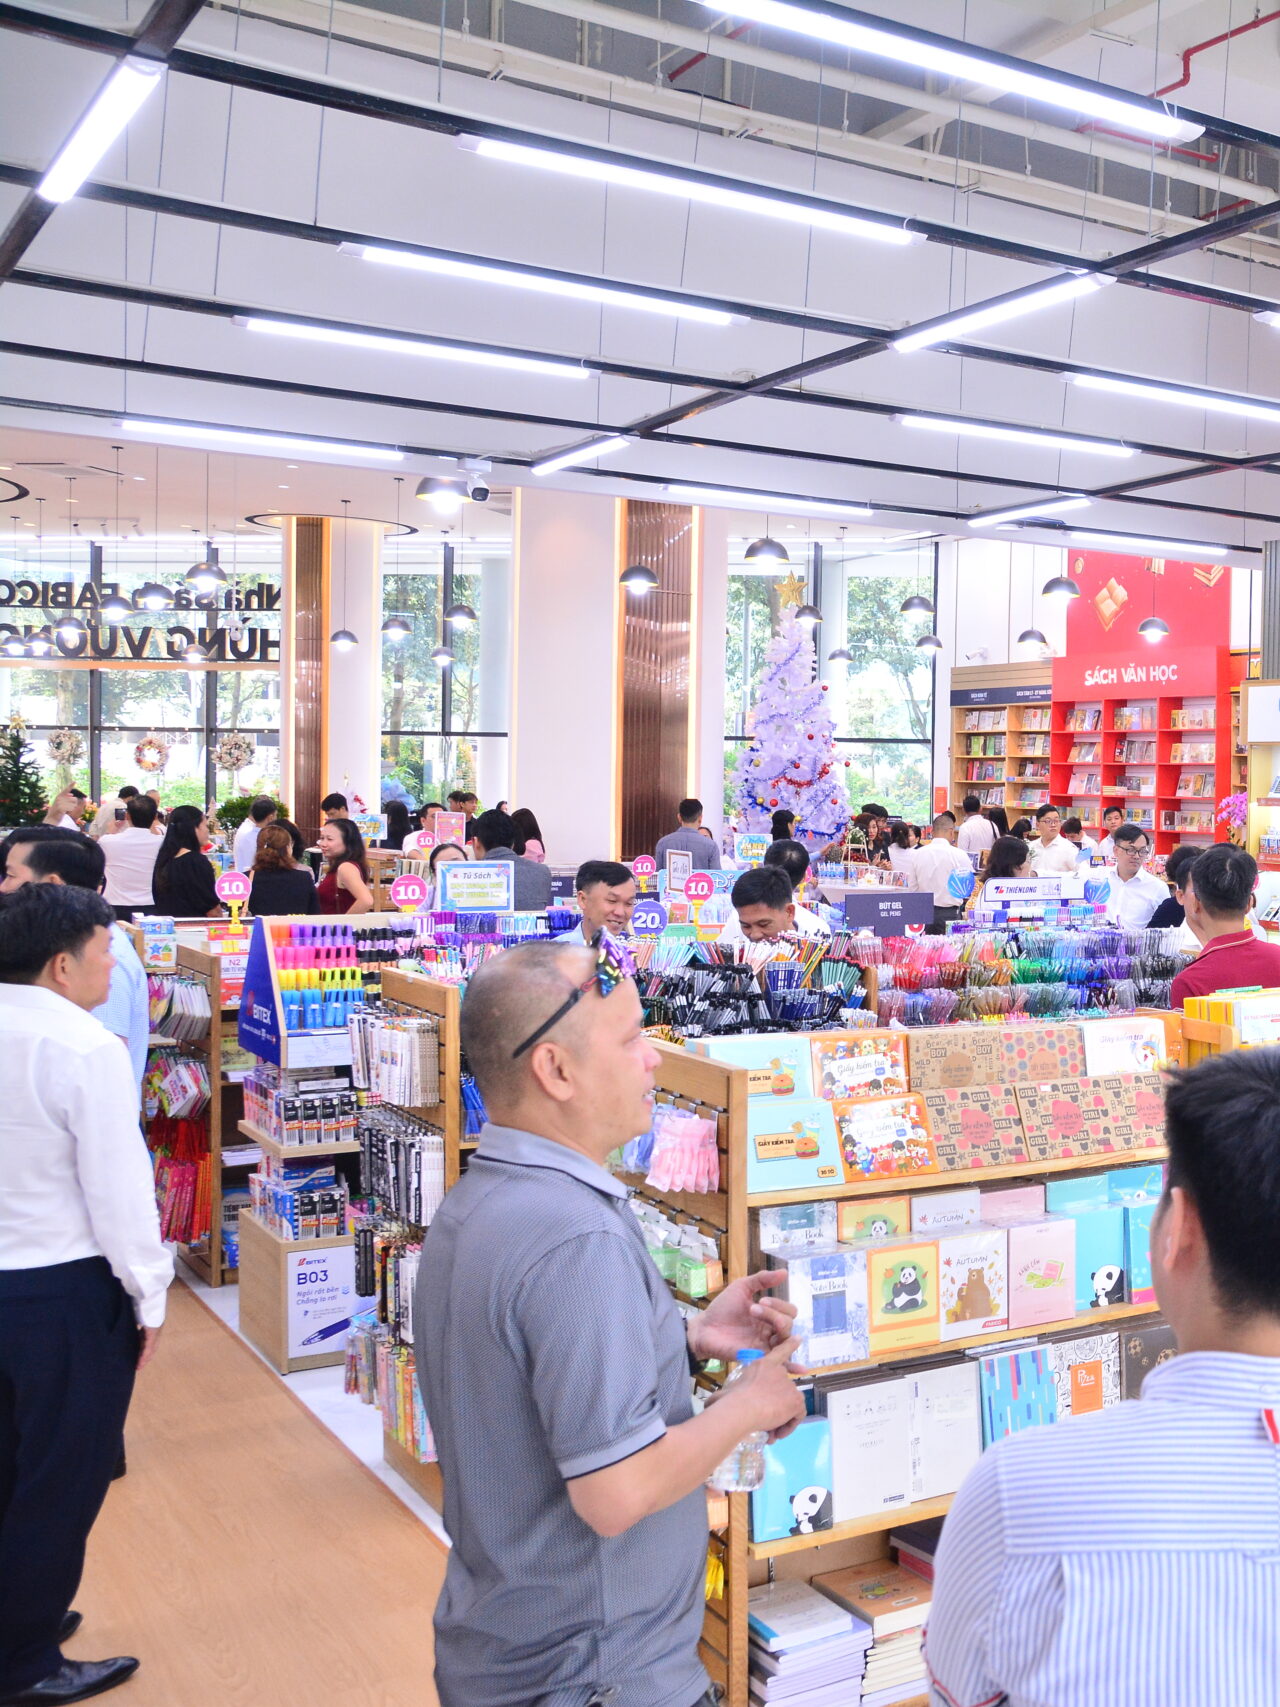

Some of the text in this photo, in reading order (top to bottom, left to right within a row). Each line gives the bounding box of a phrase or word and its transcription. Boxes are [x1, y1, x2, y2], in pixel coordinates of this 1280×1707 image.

[1084, 662, 1178, 686] SÁCH VĂN HỌC
[473, 871, 492, 880] Sách
[879, 901, 903, 910] BÚT GEL
[931, 1049, 946, 1057] BOY
[977, 1046, 991, 1054] BOY
[1105, 1080, 1121, 1089] GIRL
[1145, 1076, 1160, 1085] GIRL
[1019, 1088, 1037, 1097] GIRL
[1062, 1084, 1079, 1093] GIRL
[927, 1097, 945, 1105] GIRL
[972, 1093, 990, 1101] GIRL
[1083, 1111, 1099, 1120] GIRL
[995, 1120, 1012, 1129] GIRL
[1115, 1126, 1132, 1135] GIRL
[1030, 1136, 1047, 1145] GIRL
[937, 1146, 955, 1155] GIRL
[932, 1213, 964, 1224] AUTUMN
[805, 1228, 824, 1239] Book
[956, 1255, 988, 1267] AUTUMN
[297, 1269, 328, 1285] B03
[828, 1280, 848, 1291] Book
[1078, 1369, 1095, 1386] Pizza
